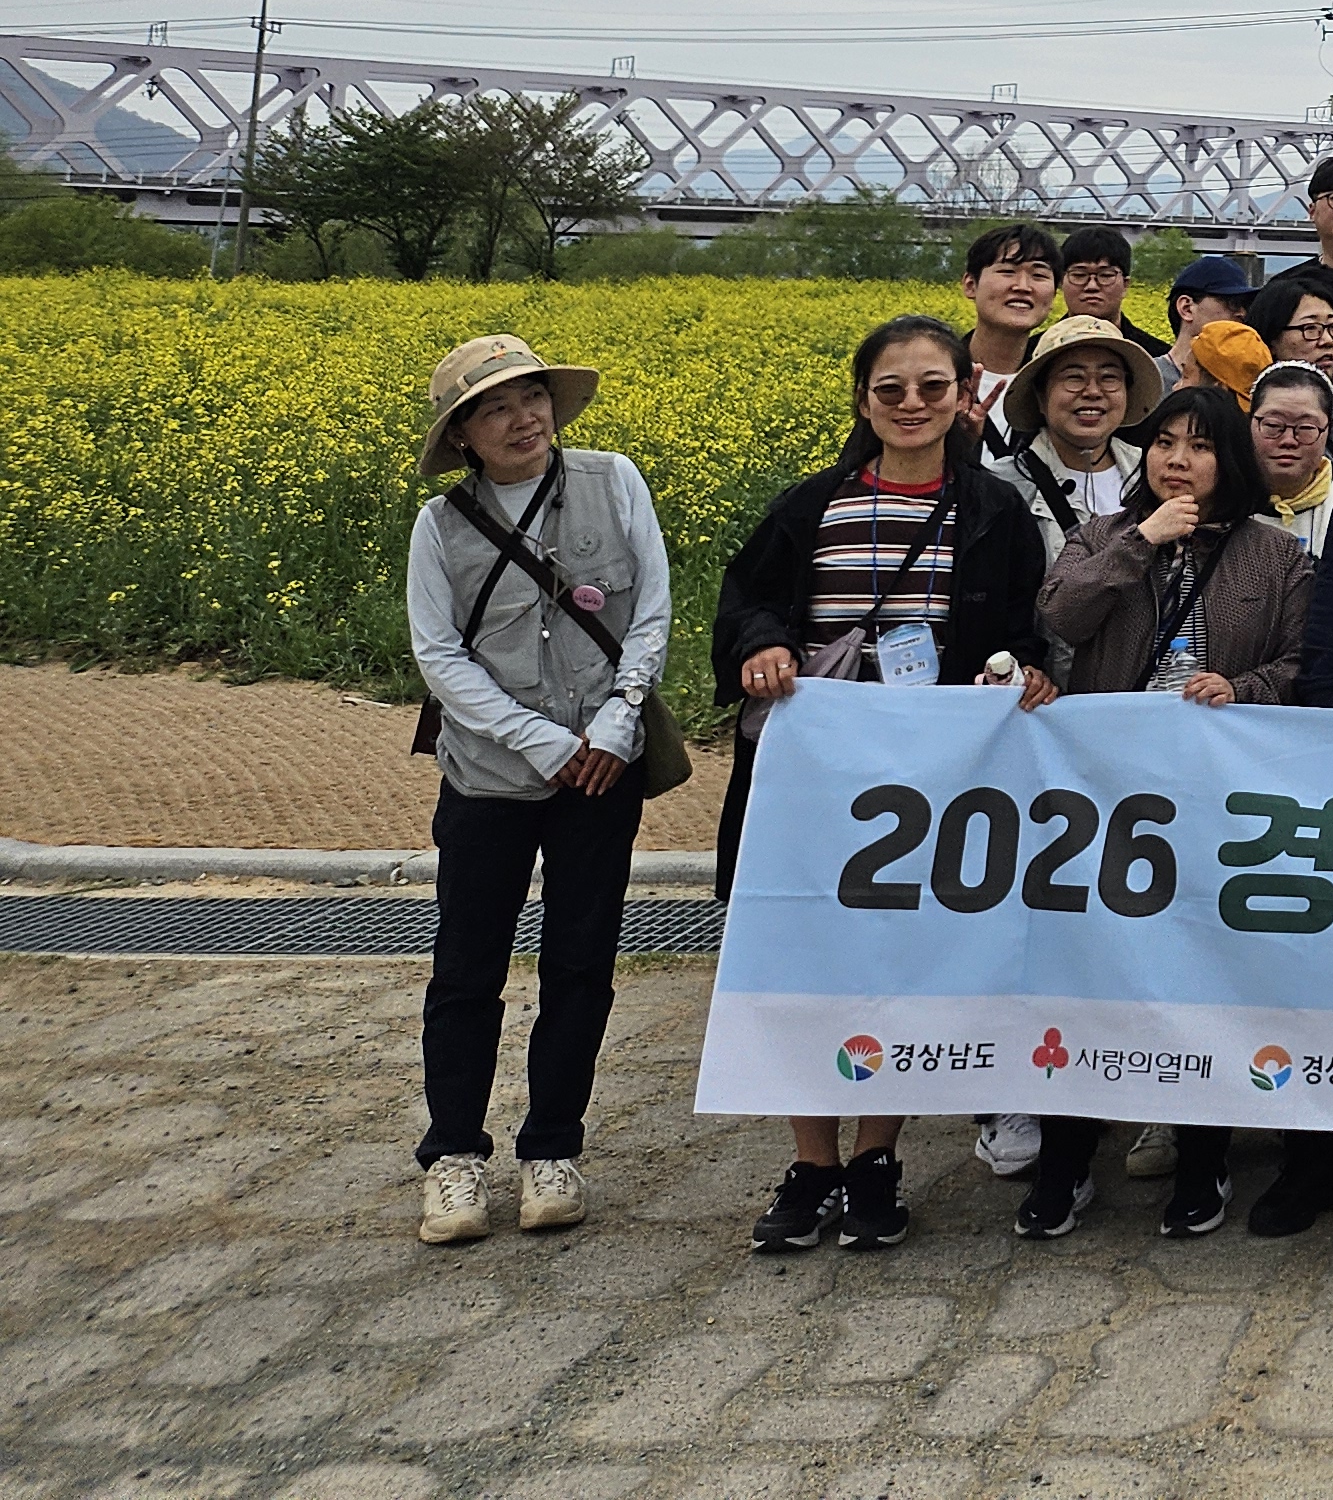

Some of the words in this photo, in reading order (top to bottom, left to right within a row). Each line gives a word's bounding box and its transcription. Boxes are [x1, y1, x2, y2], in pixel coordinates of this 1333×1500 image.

[838, 784, 1178, 918] 2026
[890, 1041, 996, 1073] 경상남도
[1074, 1047, 1214, 1084] 사랑의열매
